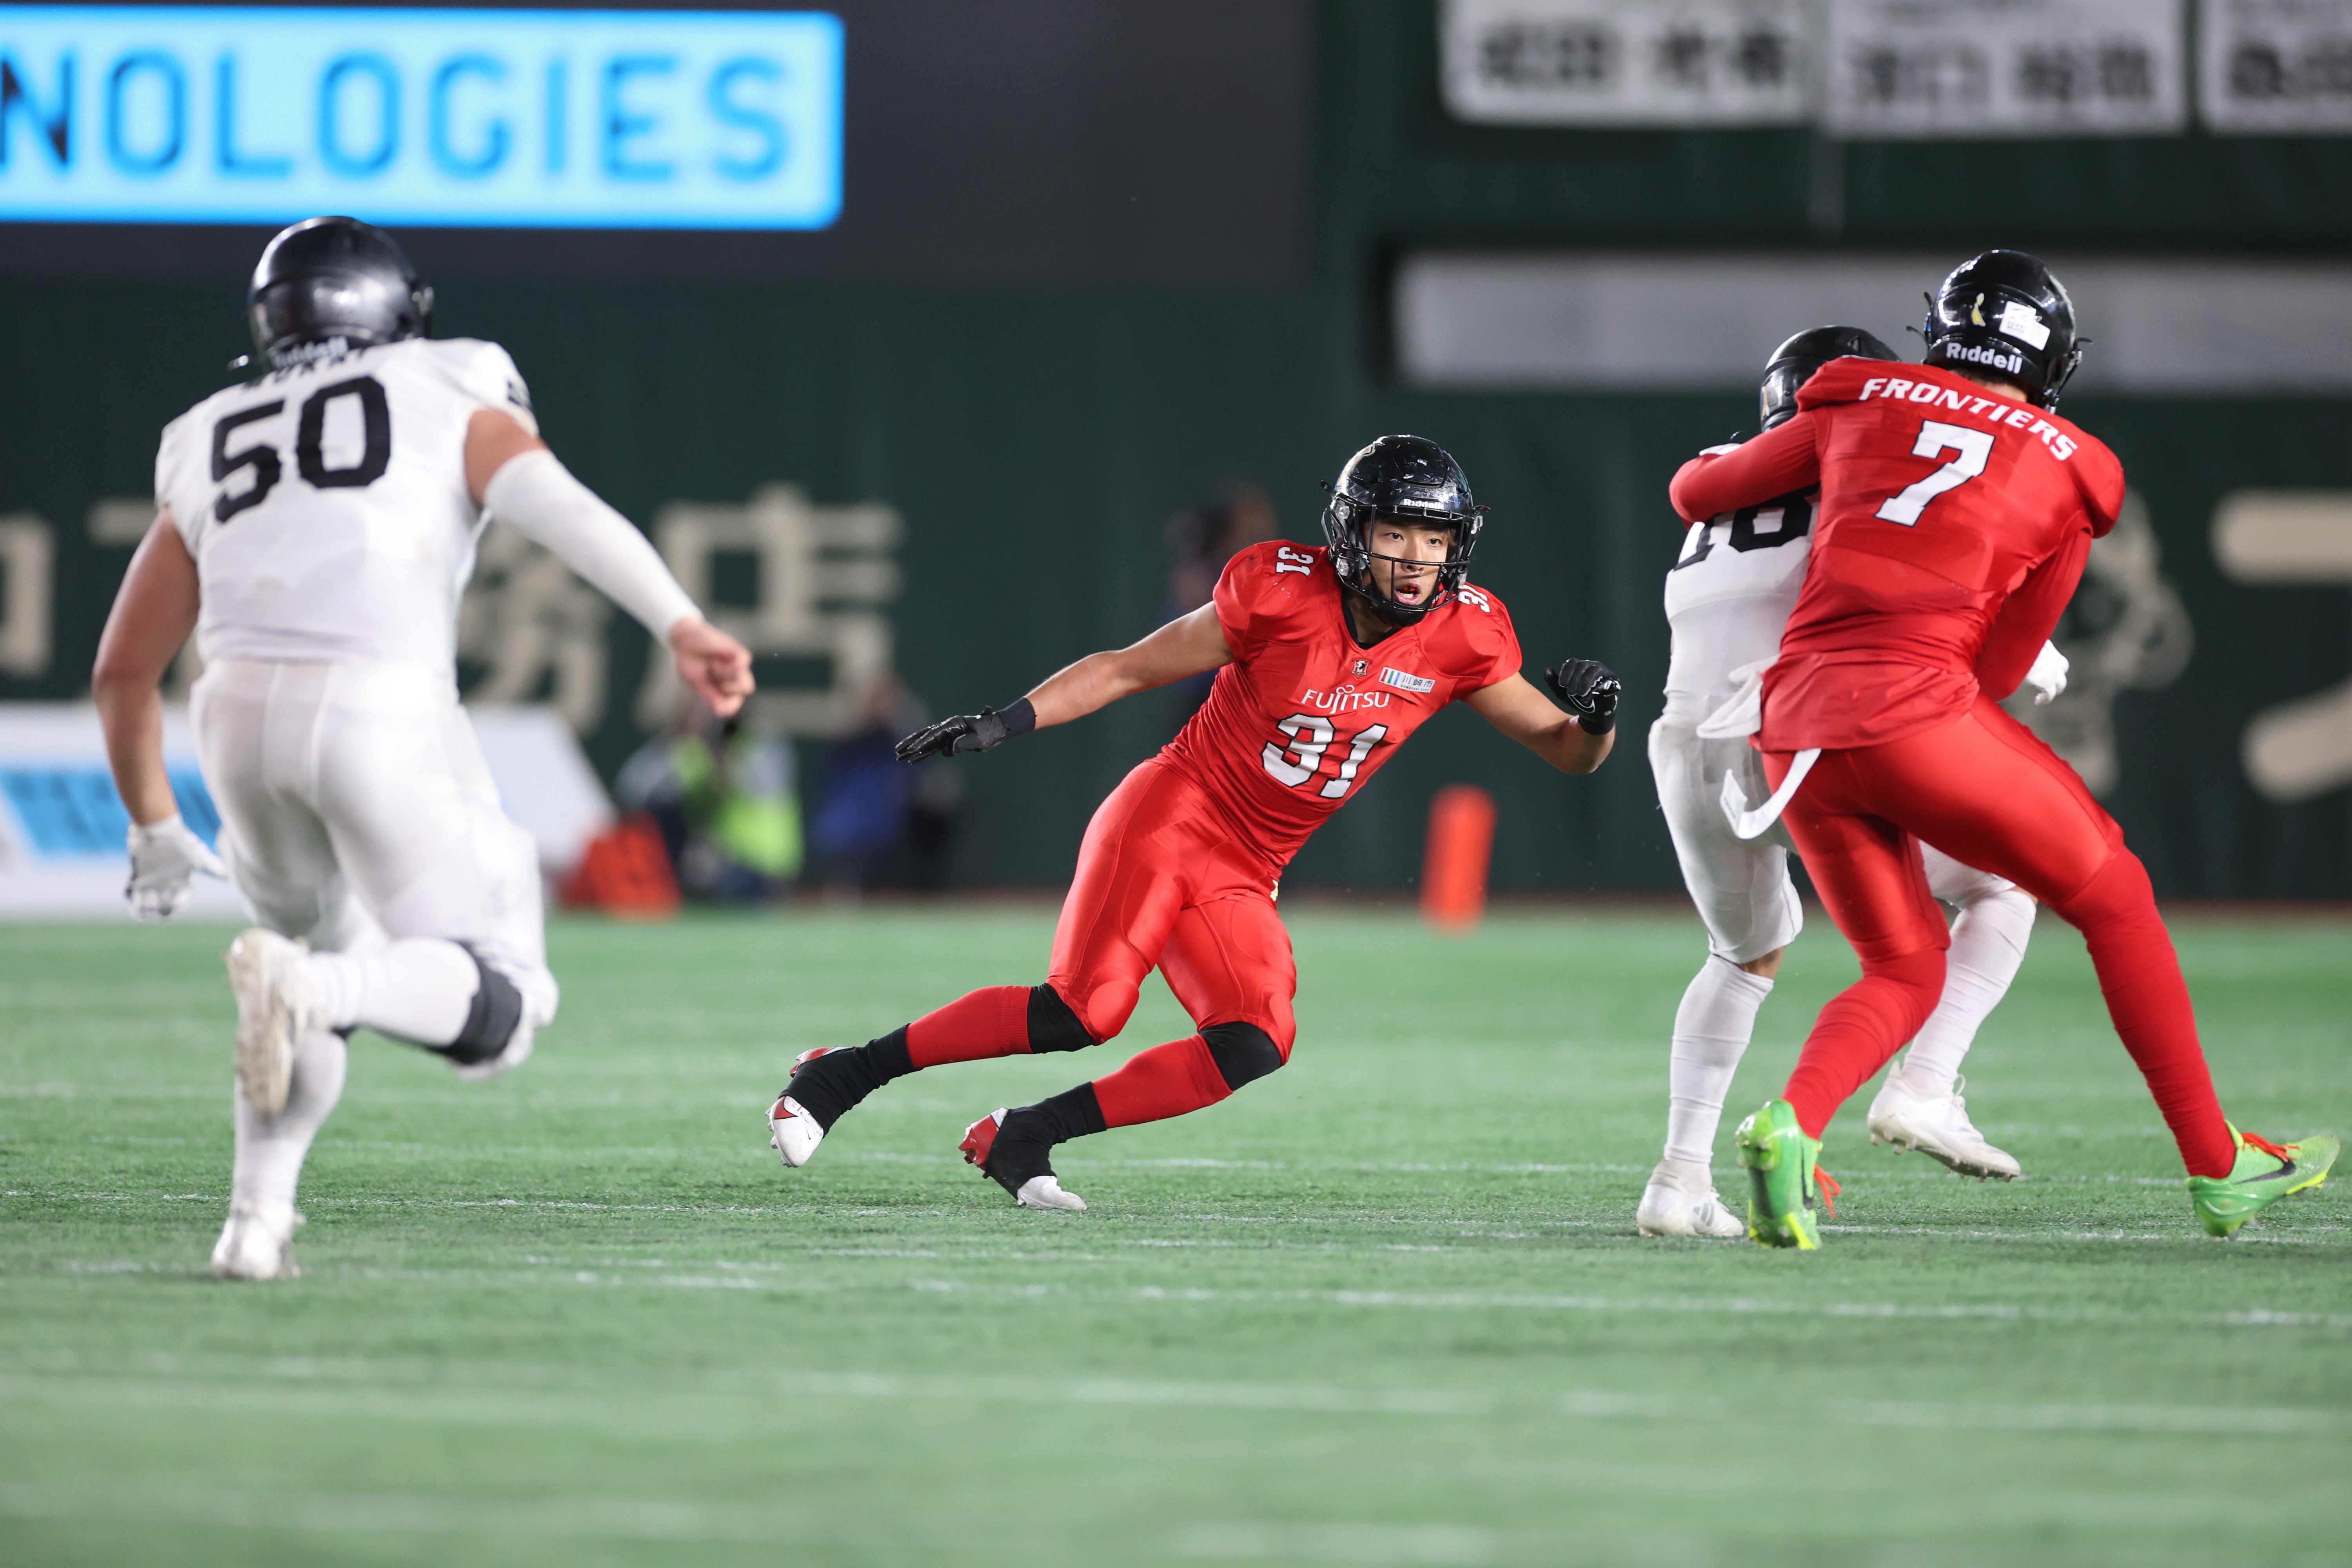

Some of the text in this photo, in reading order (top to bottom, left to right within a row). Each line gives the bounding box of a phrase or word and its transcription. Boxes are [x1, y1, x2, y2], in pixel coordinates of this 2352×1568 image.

[0, 46, 786, 182] NOLOGIES
[1945, 342, 2023, 374] Riddell
[1858, 378, 2078, 461] FRONTIERS
[211, 376, 391, 523] 50
[1874, 419, 1995, 527] 7
[1276, 546, 1314, 577] 31
[1457, 584, 1491, 613] 31
[1301, 684, 1390, 714] FUJITSU
[1402, 675, 1434, 688] 川崎市
[1261, 712, 1389, 799] 31
